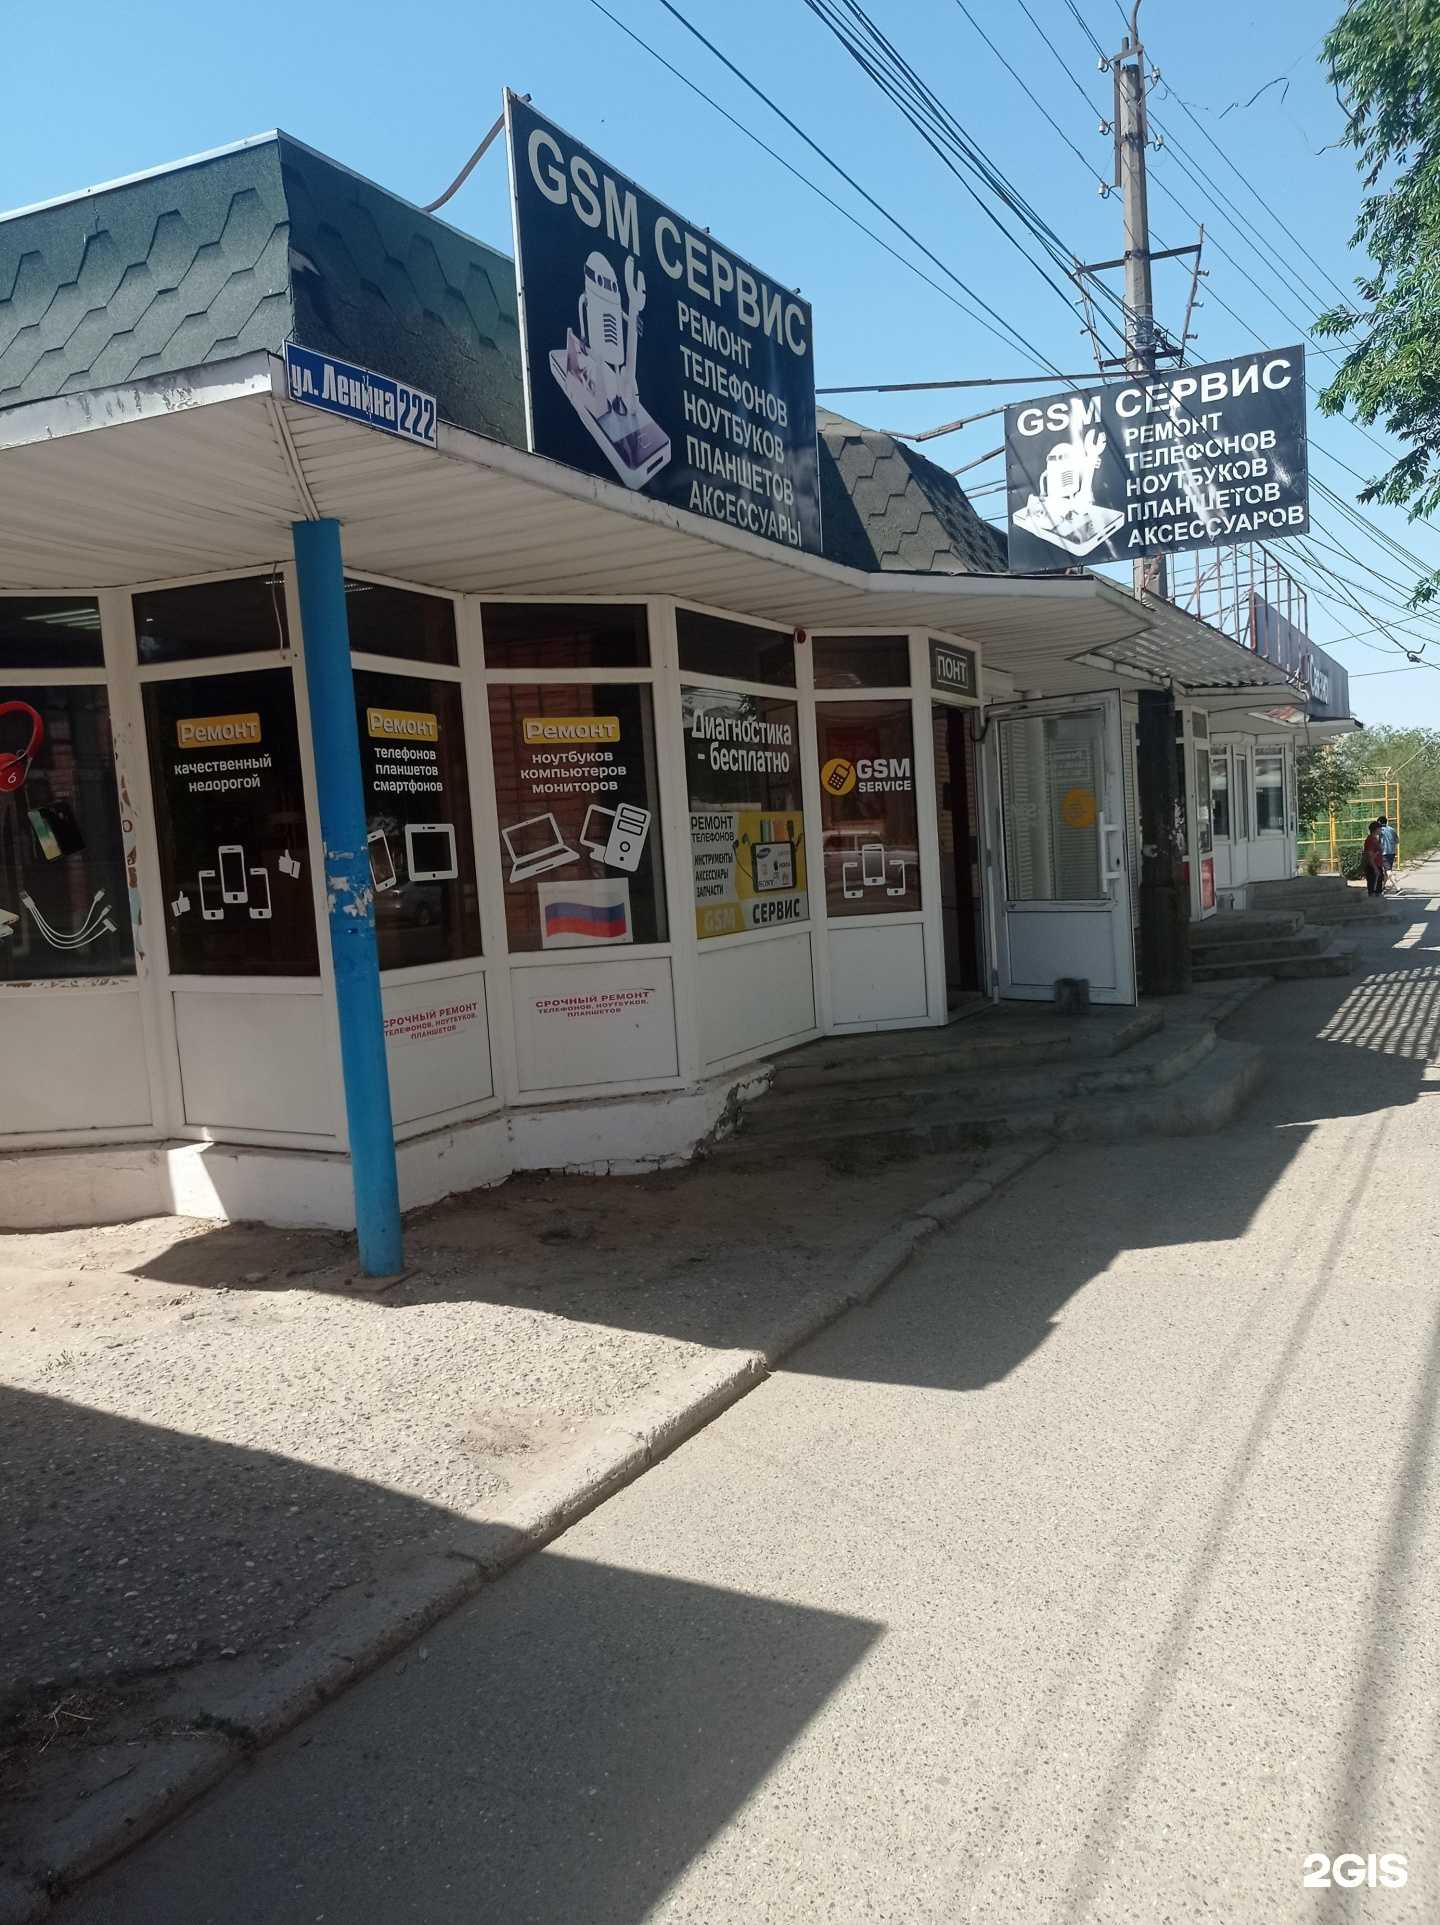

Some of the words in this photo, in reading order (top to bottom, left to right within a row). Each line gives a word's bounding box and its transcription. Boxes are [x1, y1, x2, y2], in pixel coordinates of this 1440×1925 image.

[528, 128, 640, 256] GSM
[655, 216, 807, 356] СЕРВИС
[677, 300, 751, 369] РЕМОНТ
[680, 345, 788, 428] ТЕЛЕФОНОВ
[1017, 395, 1101, 436] GSM
[1115, 359, 1292, 418] СЕРВИС
[290, 364, 319, 397] ул.
[322, 363, 396, 421] Ленина
[400, 388, 435, 441] 222
[684, 390, 784, 463] НОУТБУКОВ
[1125, 412, 1222, 446] РЕМОНТ
[1125, 430, 1276, 472] ТЕЛЕФОНОВ
[687, 436, 793, 506] ПЛАНШЕТОВ
[1126, 458, 1268, 496] НОУТБУКОВ
[689, 480, 802, 547] АКСЕССУАРЫ
[1127, 483, 1280, 522] ПЛАНШЕТОВ
[1128, 506, 1304, 547] АКСЕССУАРОВ
[937, 655, 967, 681] ПОНТ
[180, 718, 258, 743] Ремонт
[369, 712, 436, 736] Ремонт
[526, 720, 616, 739] Ремонт
[692, 710, 792, 745] Диагностика
[174, 754, 272, 775] качественный
[374, 747, 436, 761] телефонов
[532, 751, 613, 765] ноутбуков
[710, 742, 789, 773] бесплатно
[375, 763, 438, 776] планшетов
[520, 765, 626, 779] компьютеров
[856, 758, 910, 779] GSM
[188, 774, 261, 792] недорогой
[373, 779, 443, 793] смартфонов
[532, 780, 618, 794] мониторов
[858, 780, 911, 793] SERVICE
[691, 816, 733, 830] РЕМОНТ
[691, 832, 735, 843] ТЕЛЕФОНОВ
[695, 853, 733, 866] ИНСТРУМЕНТЫ
[696, 869, 728, 881] АКСЕССУАРЫ
[697, 885, 723, 897] ЗАПЧАСТИ
[752, 899, 800, 923] СЕРВИС
[536, 996, 597, 1008] СРОЧНЫЙ
[601, 992, 649, 1002] РЕМОНТ
[384, 1011, 437, 1028] СРОЧНЫЙ
[439, 1002, 477, 1017] РЕМОНТ
